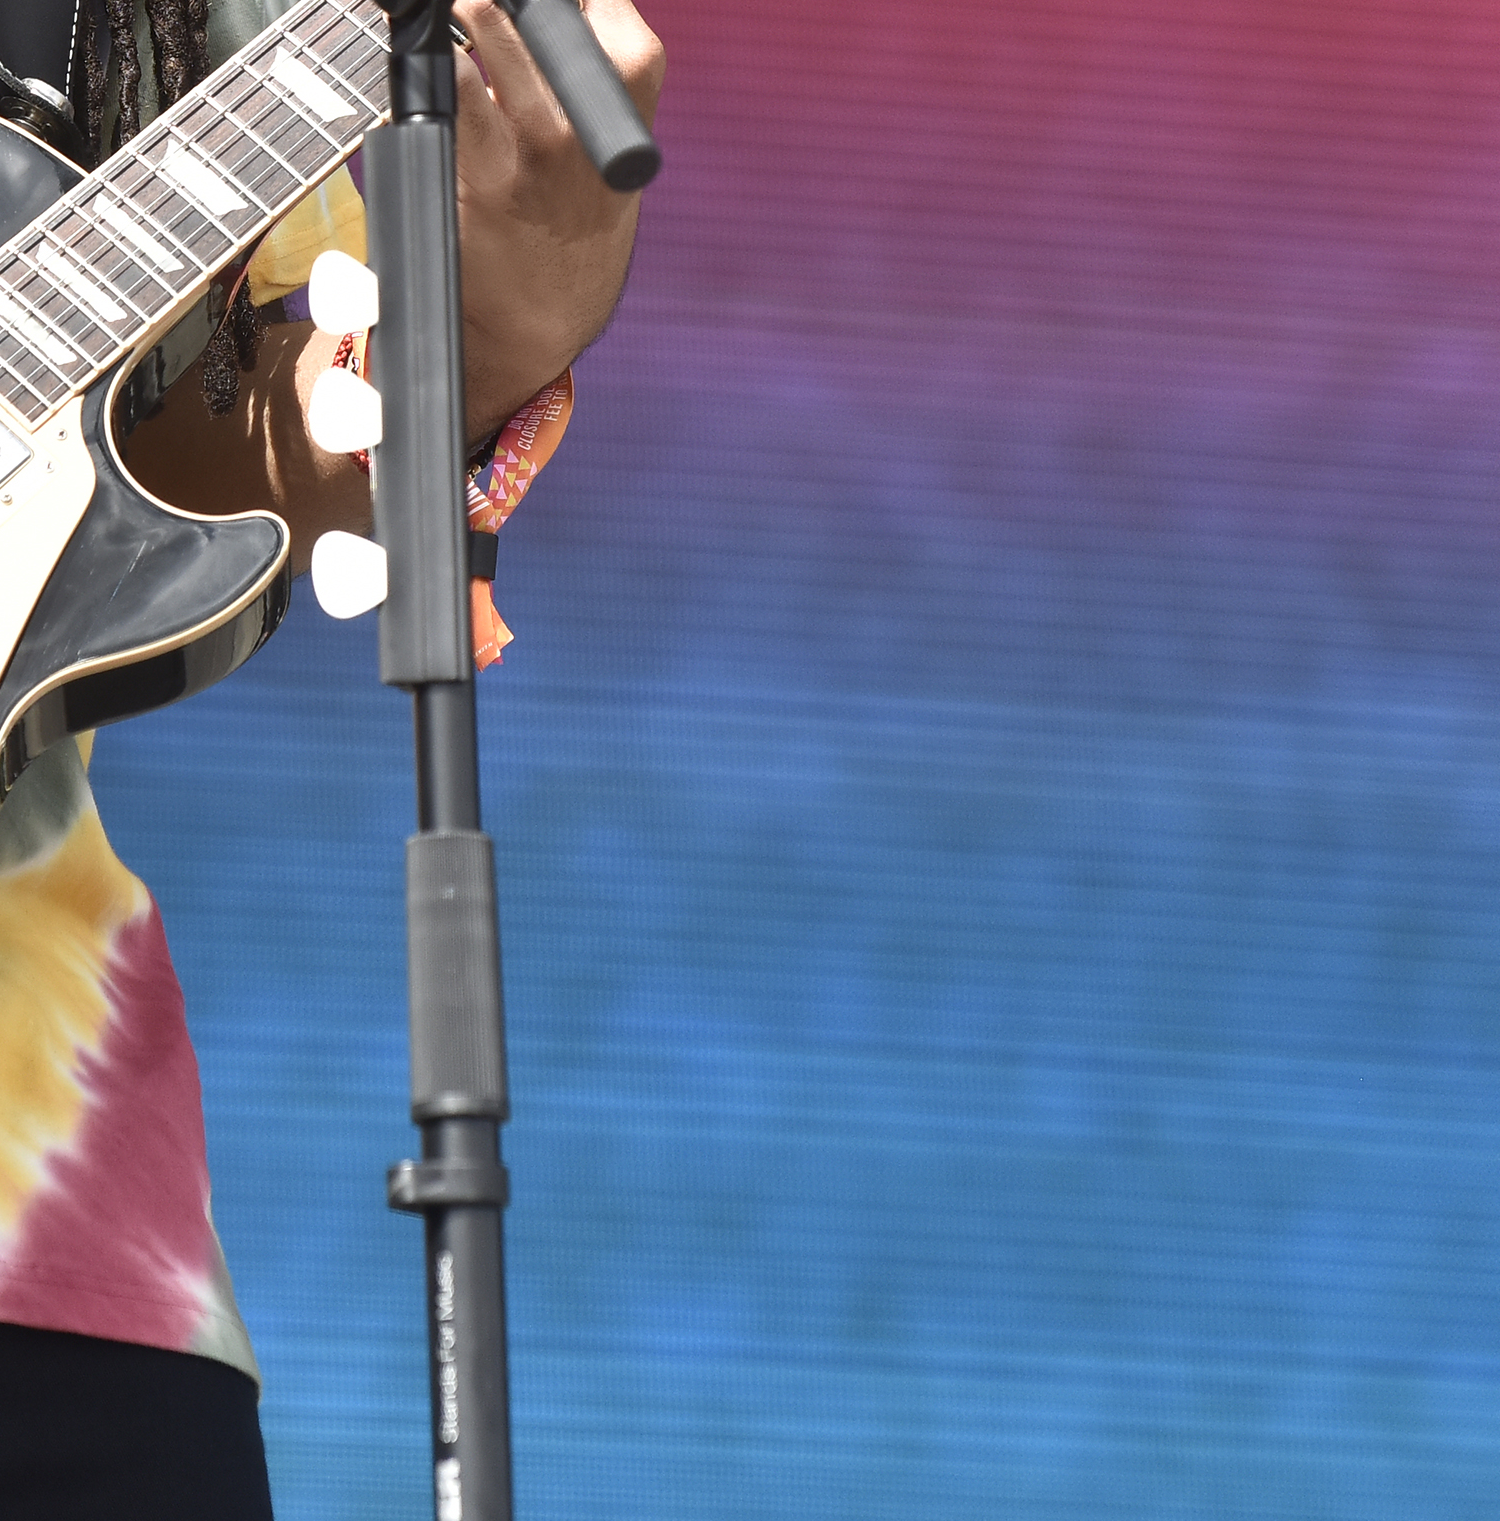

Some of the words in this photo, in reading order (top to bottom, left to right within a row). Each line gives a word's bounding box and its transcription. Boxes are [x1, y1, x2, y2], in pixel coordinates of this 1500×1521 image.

[552, 389, 568, 400] TO
[543, 403, 564, 421] FEE
[517, 408, 546, 451] CLOSURE
[438, 1364, 460, 1444] Stands
